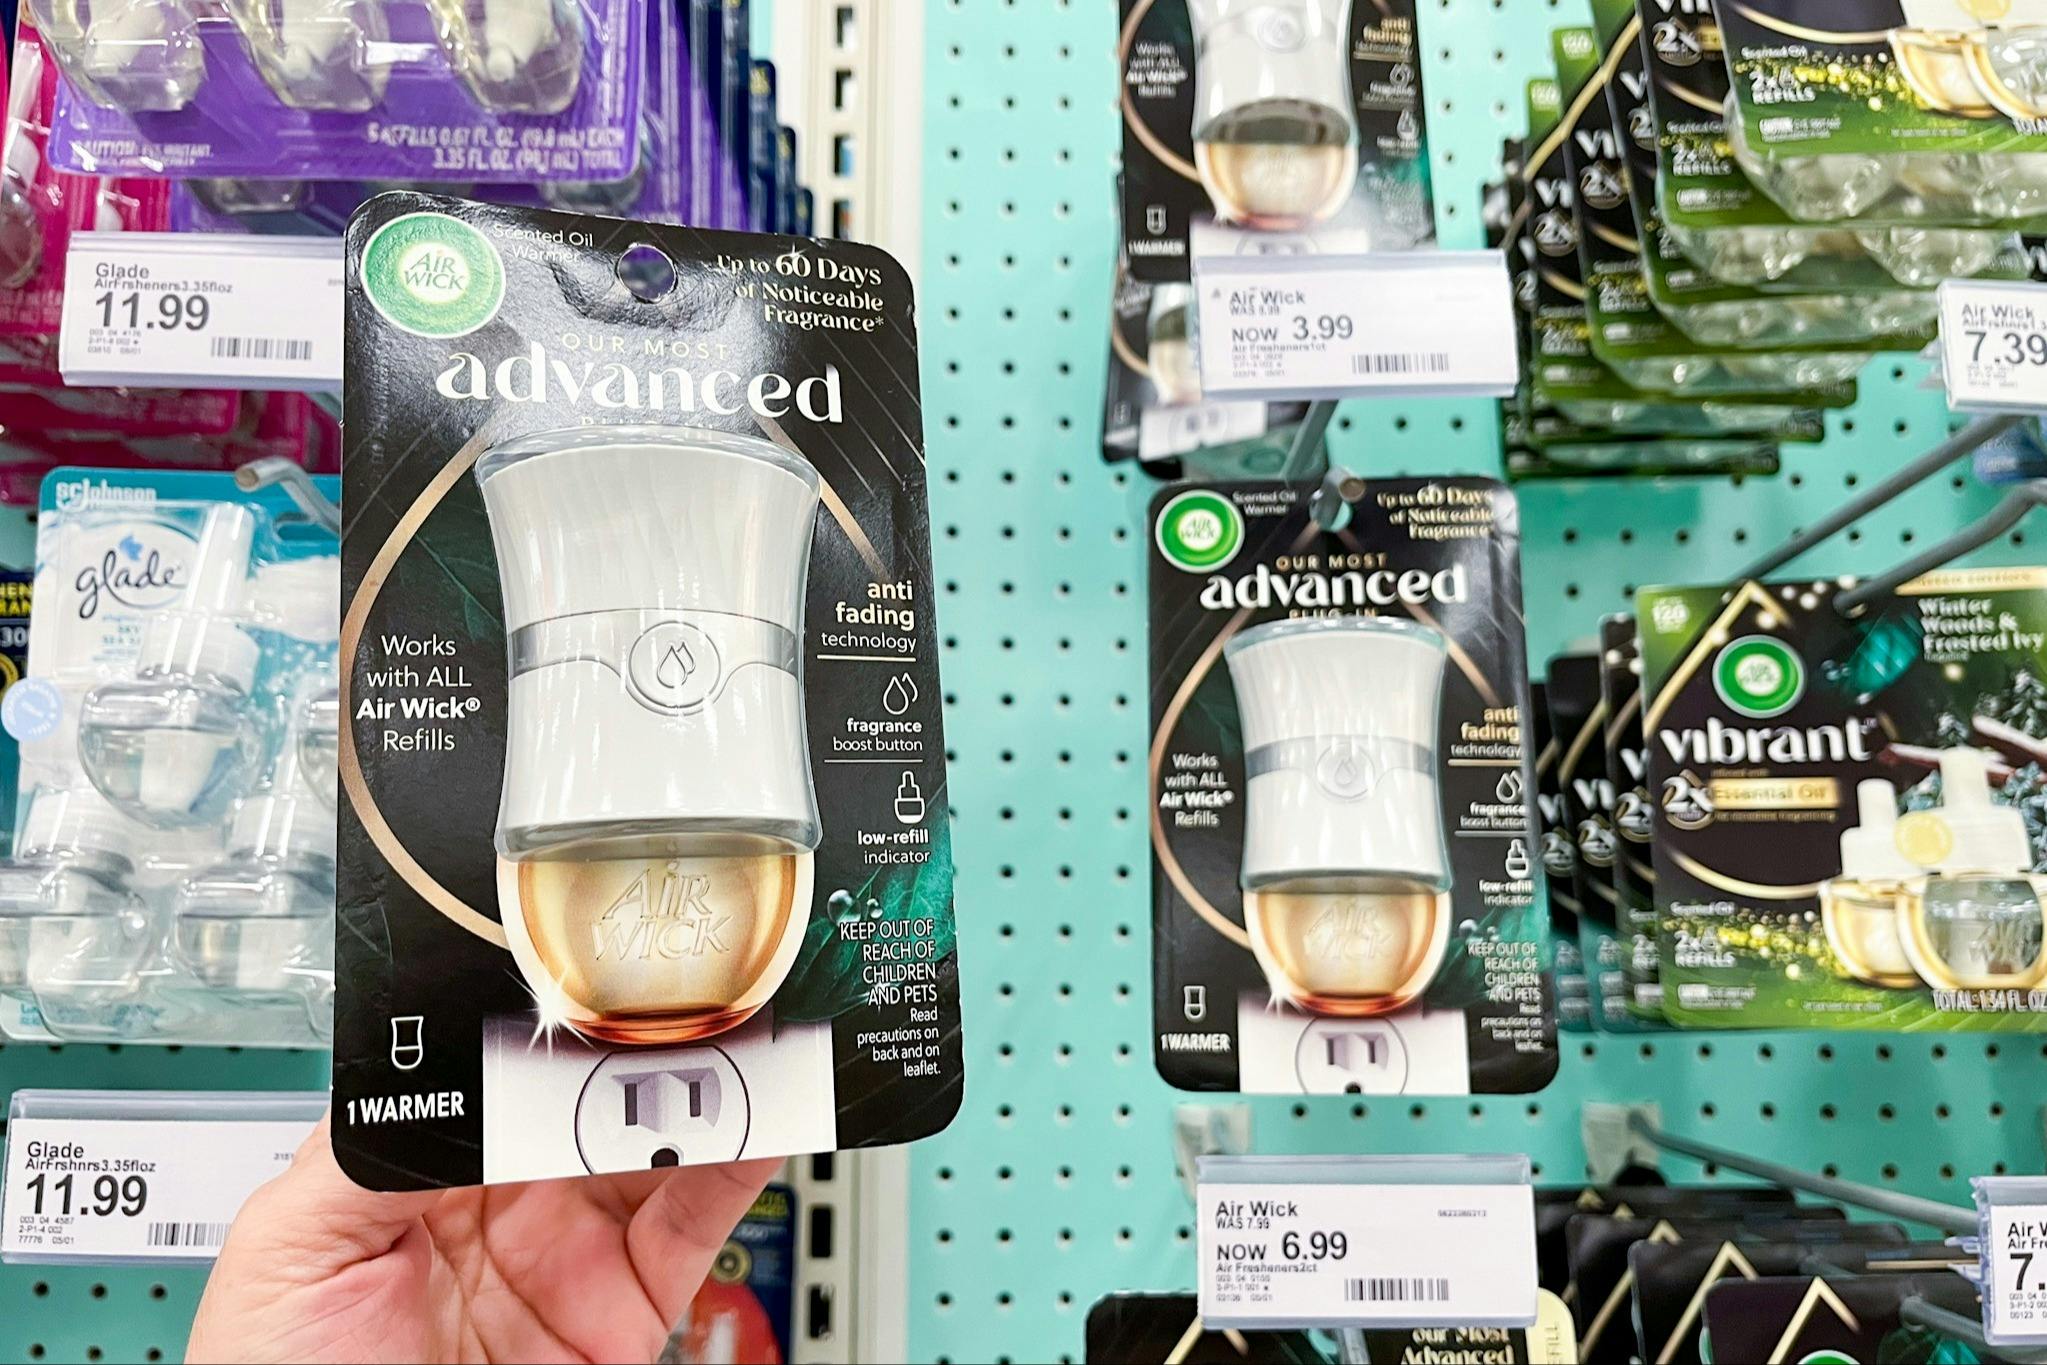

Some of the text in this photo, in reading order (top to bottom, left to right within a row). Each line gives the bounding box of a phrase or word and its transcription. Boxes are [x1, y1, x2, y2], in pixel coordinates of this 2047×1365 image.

[491, 224, 594, 248] Scented Oil
[511, 245, 579, 263] Warmer
[95, 262, 150, 280] Glade
[717, 251, 883, 289] Up to 60 Days
[735, 280, 884, 312] of Noticeable
[1229, 289, 1306, 304] Air Wick
[94, 291, 211, 332] 11.99
[1961, 303, 1986, 318] Air
[1231, 315, 1353, 342] NOW 3.99
[561, 331, 731, 361] OUR MOST
[1964, 330, 2047, 366] 7.39
[434, 340, 845, 425] advanced
[1276, 553, 1388, 571] OUR MOST
[75, 549, 187, 620] glade
[867, 580, 914, 601] anti
[1199, 562, 1471, 610] advanced
[835, 601, 916, 632] fading
[380, 633, 457, 656] Works
[821, 631, 918, 654] technology
[366, 664, 473, 688] with ALL
[355, 697, 396, 720] Air
[846, 717, 923, 736] fragrance
[1460, 722, 1521, 745] fading
[383, 727, 456, 752] Refills
[832, 735, 924, 752] boost button
[1659, 716, 1873, 765] vibrant
[1172, 752, 1220, 770] Works
[1199, 771, 1229, 789] ALL
[1159, 791, 1183, 809] Air
[1174, 809, 1220, 828] Refills
[857, 828, 930, 846] low-refill
[863, 849, 931, 866] indicator
[840, 918, 935, 941] KEEP OUT OF
[862, 939, 936, 963] REACH OF
[862, 962, 937, 985] CHILDREN
[867, 983, 938, 1007] AND PETS
[909, 1006, 938, 1022] Read
[856, 1027, 940, 1049] precautions on
[1169, 1032, 1231, 1052] WARMER
[872, 1043, 941, 1062] back and on
[903, 1060, 942, 1077] leaflet.
[347, 1091, 465, 1126] 1 WARMER
[27, 1141, 84, 1160] Glade
[26, 1173, 148, 1217] 11.99
[1216, 1200, 1299, 1218] Air Wick
[1216, 1217, 1271, 1230] WAS 7.99
[2007, 1221, 2034, 1238] Air
[1216, 1230, 1348, 1262] NOW 6.99
[2007, 1238, 2027, 1249] Air
[1215, 1262, 1232, 1273] Air
